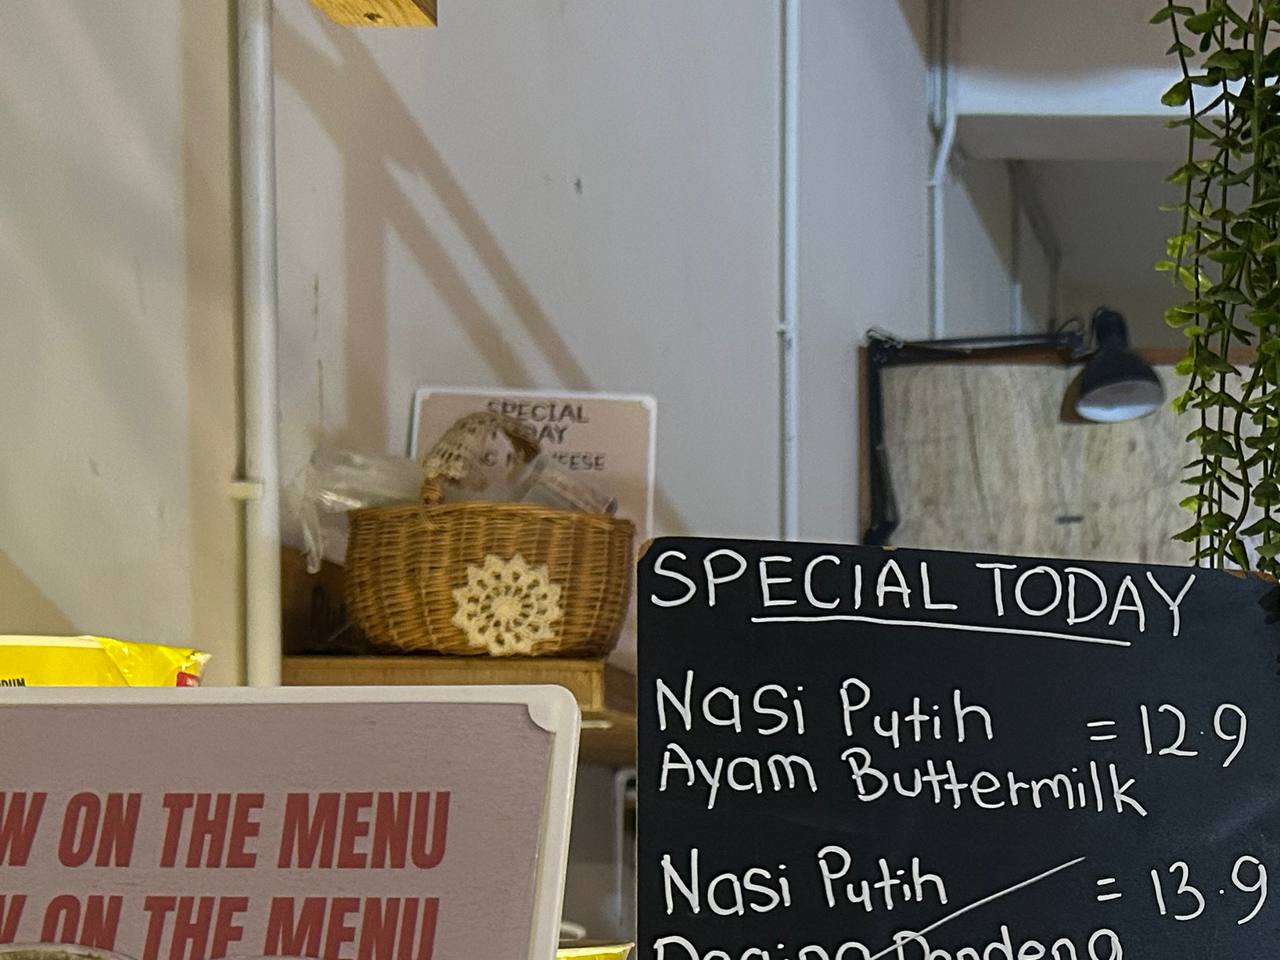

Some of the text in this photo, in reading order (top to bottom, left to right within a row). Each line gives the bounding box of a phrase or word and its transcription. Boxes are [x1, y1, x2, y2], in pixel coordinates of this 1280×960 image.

[651, 550, 1196, 636] SPECIAL TODAY
[657, 670, 806, 736] Nasi
[841, 678, 993, 749] Putih
[1141, 703, 1248, 767] 12.9
[659, 744, 1147, 816] Ayam Buttermilk
[58, 792, 142, 868] ON
[160, 793, 265, 868] THE
[277, 791, 450, 869] MENU
[40, 894, 123, 950] ON
[661, 848, 791, 915] Nasi
[818, 845, 948, 910] Putih
[1150, 855, 1268, 925] 13.9
